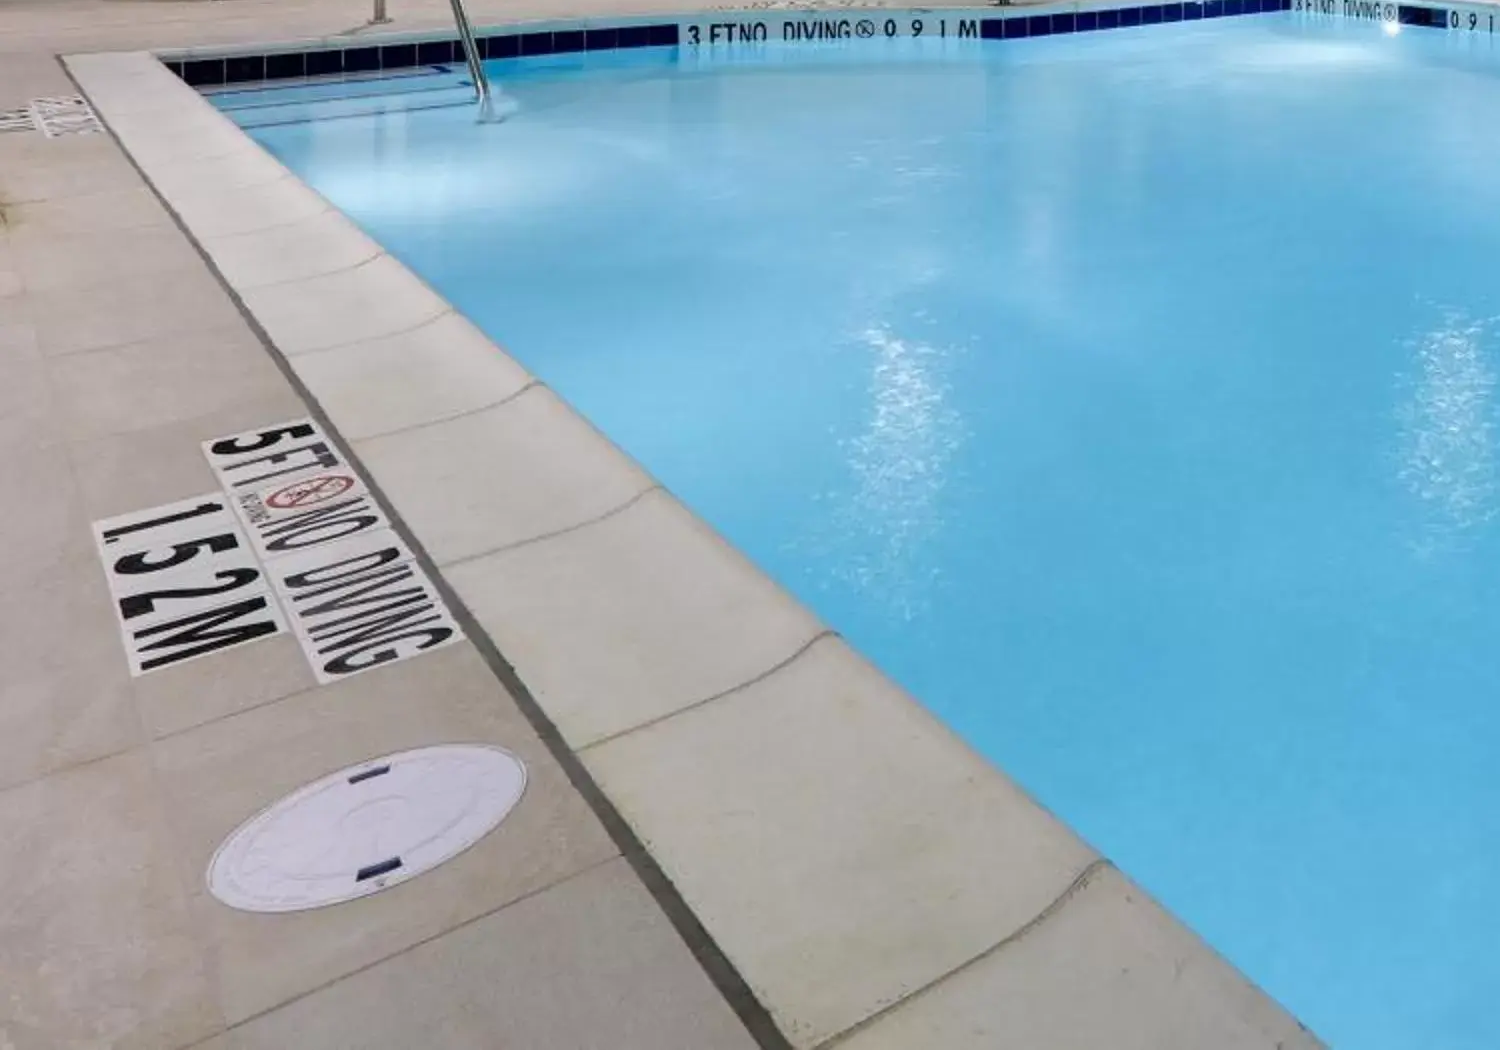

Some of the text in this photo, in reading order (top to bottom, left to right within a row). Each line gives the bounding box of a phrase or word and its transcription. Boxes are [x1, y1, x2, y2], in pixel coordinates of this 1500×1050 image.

[687, 24, 701, 45] 3
[783, 17, 851, 41] DIVING
[211, 423, 453, 675] 5 FT NO DIVING
